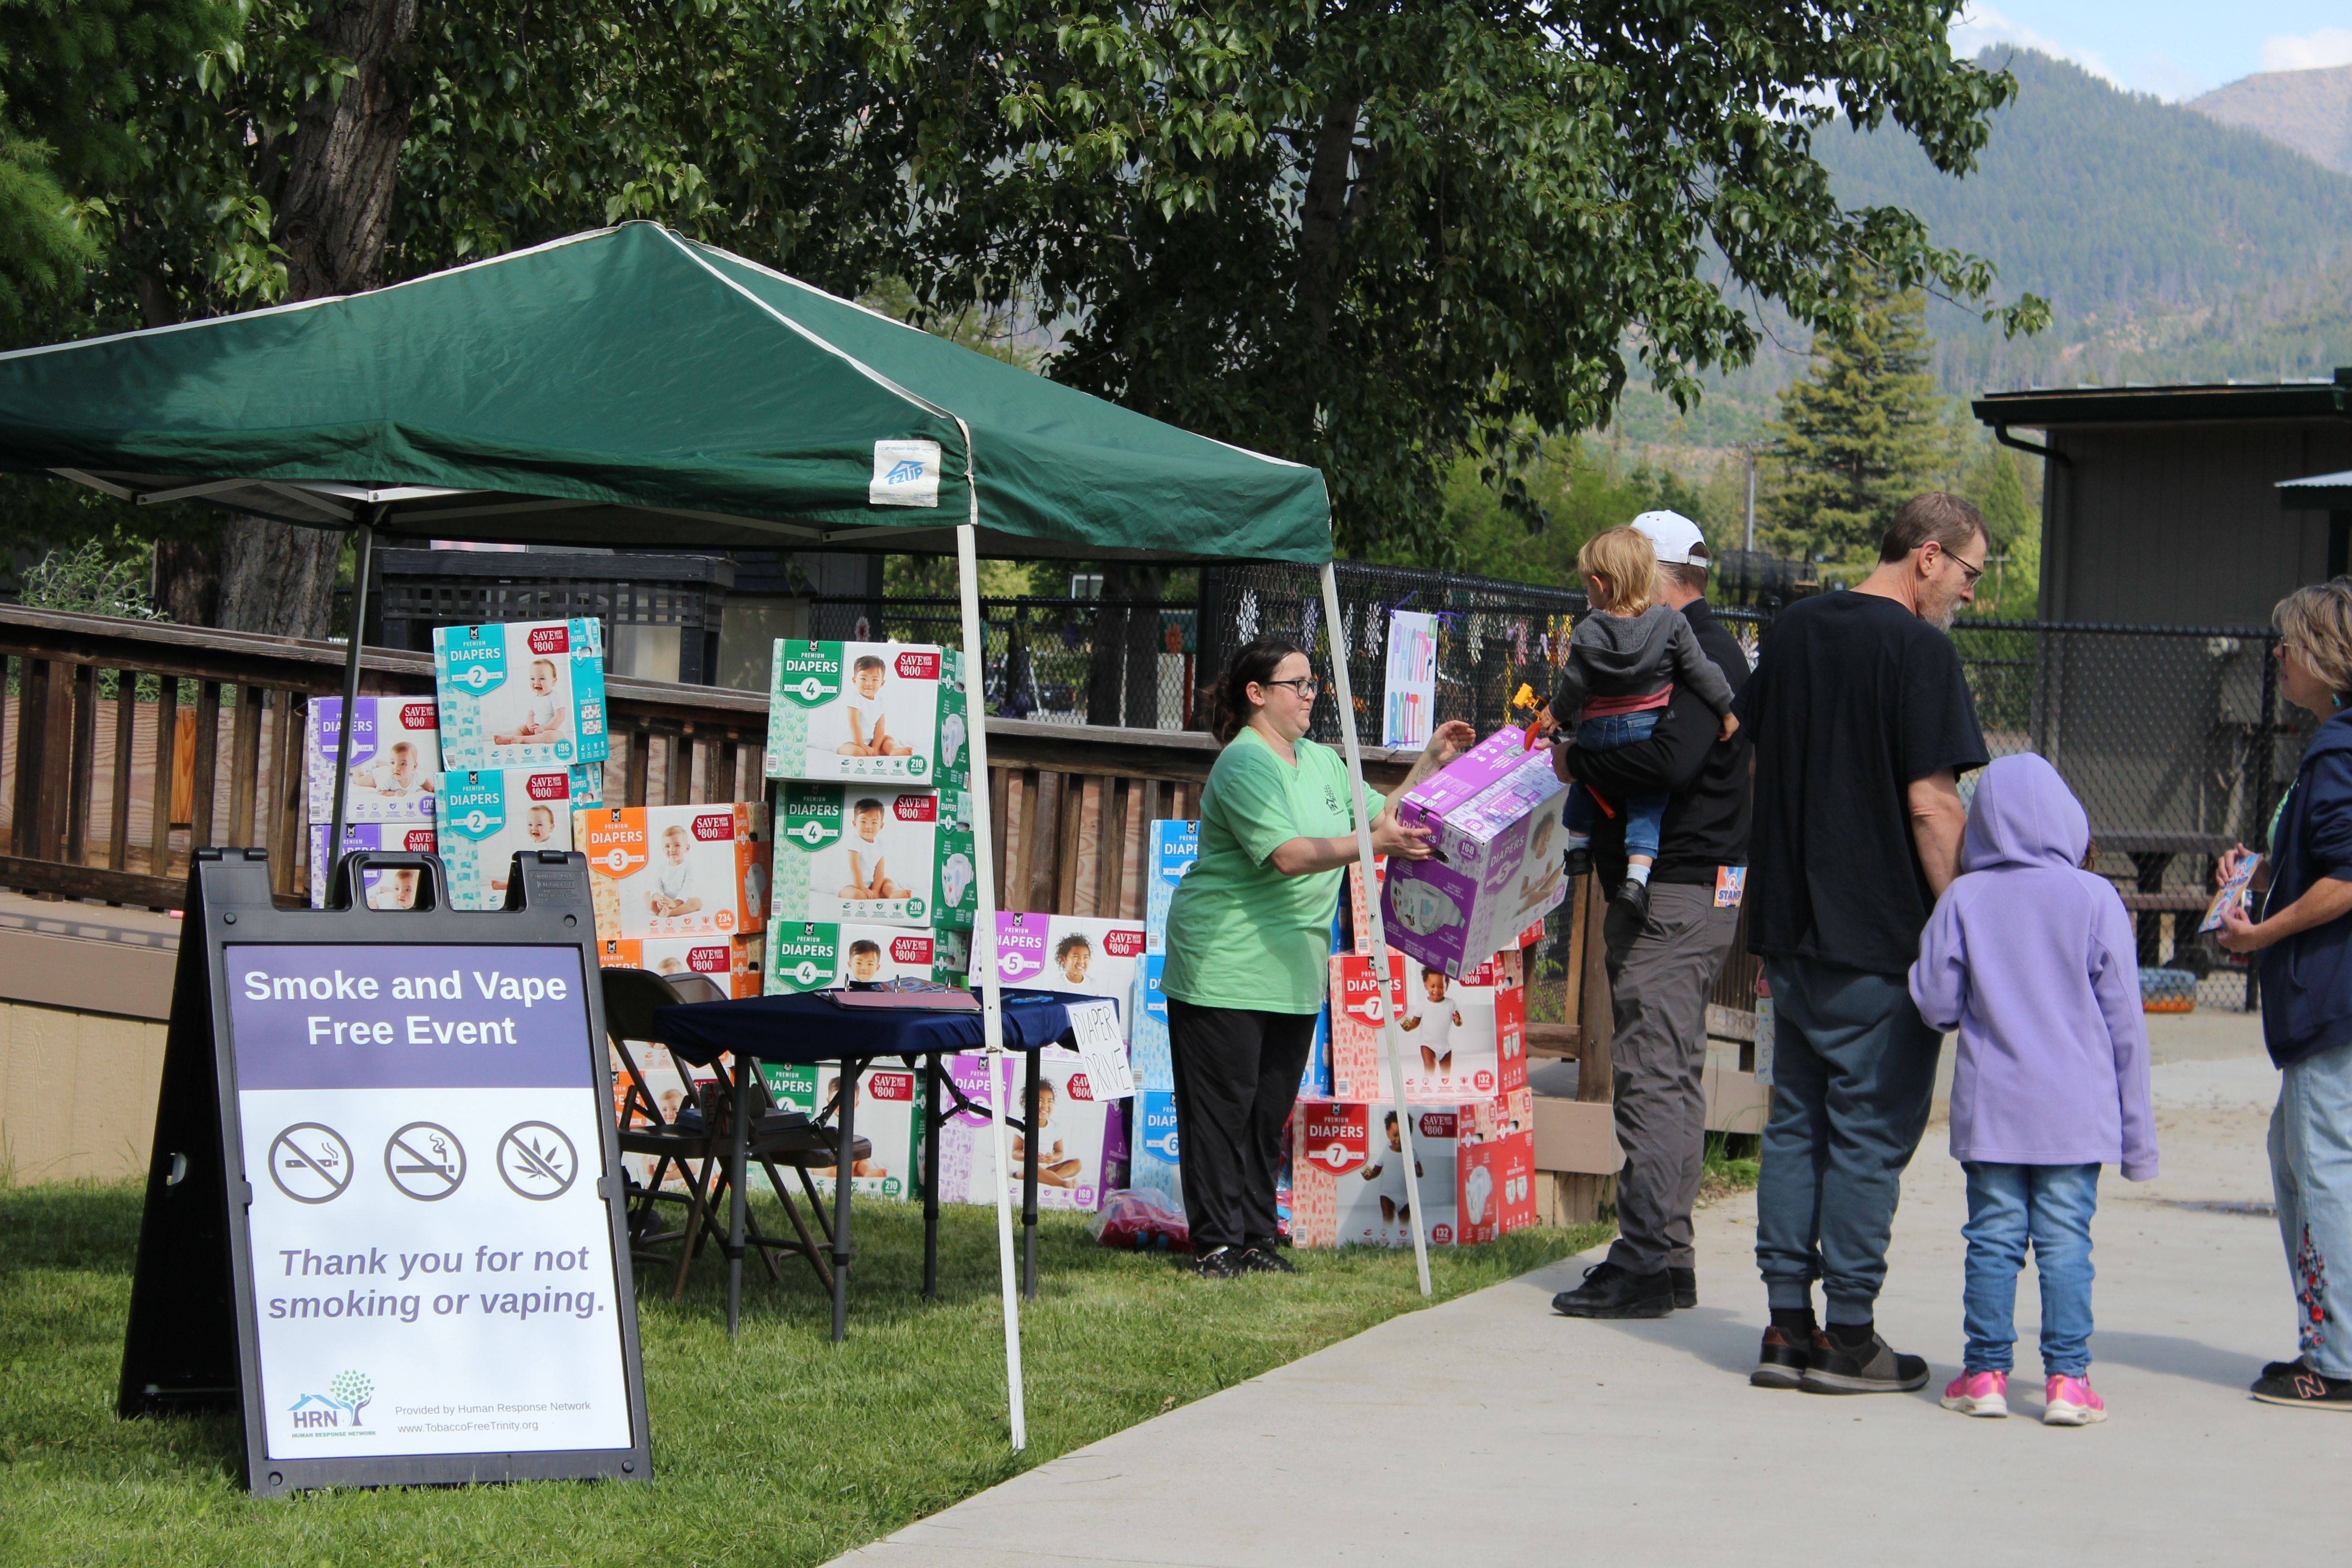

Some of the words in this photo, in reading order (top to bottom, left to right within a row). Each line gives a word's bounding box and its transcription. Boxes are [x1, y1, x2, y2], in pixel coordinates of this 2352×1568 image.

[533, 631, 554, 641] SAVE
[533, 641, 554, 652] $800
[450, 648, 501, 662] DIAPERS
[900, 655, 923, 666] SAVE
[786, 661, 838, 673] DIAPERS
[900, 665, 921, 677] $800
[943, 662, 955, 672] DIAPERS
[473, 669, 482, 683] 2
[806, 681, 815, 696] 4
[405, 706, 426, 716] SAVE
[323, 720, 372, 732] DIAERS
[405, 717, 425, 727] $800
[1389, 691, 1426, 749] BOOTH
[558, 743, 569, 752] 196
[911, 759, 923, 768] 210
[531, 777, 553, 787] SAVE
[572, 780, 587, 789] DIAPERS
[532, 787, 552, 798] $800
[450, 793, 500, 806] DIAPERS
[898, 798, 920, 808] SAVE
[789, 804, 839, 816] DIAPERS
[898, 808, 918, 819] $800
[941, 803, 956, 812] DIAPERS
[472, 814, 480, 828] 2
[697, 818, 719, 828] SAVE
[409, 833, 430, 843] SAVE
[591, 831, 643, 844] DIAPERS
[697, 828, 718, 839] $800
[808, 825, 817, 839] 4
[409, 843, 429, 852] $800
[1165, 843, 1198, 855] DIAPE
[1462, 842, 1475, 855] 168
[1490, 835, 1524, 867] DIAPERS
[614, 852, 623, 867] 3
[1500, 864, 1508, 880] 5
[910, 902, 922, 911] 210
[718, 913, 732, 923] 234
[997, 935, 1042, 948] IAPERS
[1109, 932, 1132, 944] SAVE
[782, 944, 833, 956] DIAPERS
[895, 940, 918, 950] SAVE
[1109, 943, 1130, 955] $800
[692, 950, 714, 960] SAVE
[895, 950, 916, 961] $800
[692, 960, 713, 971] $800
[1008, 956, 1018, 970] 5
[801, 965, 811, 980] 4
[244, 970, 379, 1000] Smoke
[392, 969, 462, 1000] and
[472, 970, 567, 1008] Vape
[1347, 979, 1401, 992] DIAPRS
[1371, 1001, 1379, 1015] 7
[307, 1016, 394, 1045] Free
[406, 1015, 517, 1045] Event
[1073, 1006, 1117, 1045] DIAPER
[1085, 1048, 1131, 1093] DRIVE
[874, 1076, 897, 1087] SAVE
[955, 1078, 1007, 1092] DIAPES
[1477, 1074, 1490, 1084] 132
[874, 1087, 895, 1098] $800
[1148, 1115, 1178, 1127] DIAP
[1424, 1116, 1445, 1126] SAVE
[1310, 1125, 1364, 1138] DIAPERS
[1424, 1125, 1443, 1135] $800
[1169, 1137, 1179, 1151] 6
[1333, 1148, 1341, 1162] 7
[885, 1181, 898, 1190] 210
[1078, 1189, 1091, 1198] 168
[1436, 1228, 1449, 1237] 132
[279, 1247, 388, 1277] Thank
[398, 1250, 463, 1281] you
[475, 1245, 524, 1273] for
[534, 1245, 590, 1272] not
[268, 1289, 420, 1323] smoking
[432, 1290, 470, 1316] or
[480, 1285, 605, 1321] vaping.
[395, 1405, 440, 1416] Provided
[443, 1405, 455, 1416] by
[458, 1404, 495, 1414] Human
[497, 1403, 548, 1414] Response
[550, 1401, 591, 1411] Network
[293, 1410, 338, 1429] HRN
[397, 1421, 539, 1434] www.TobaccoFreeTrinity.org
